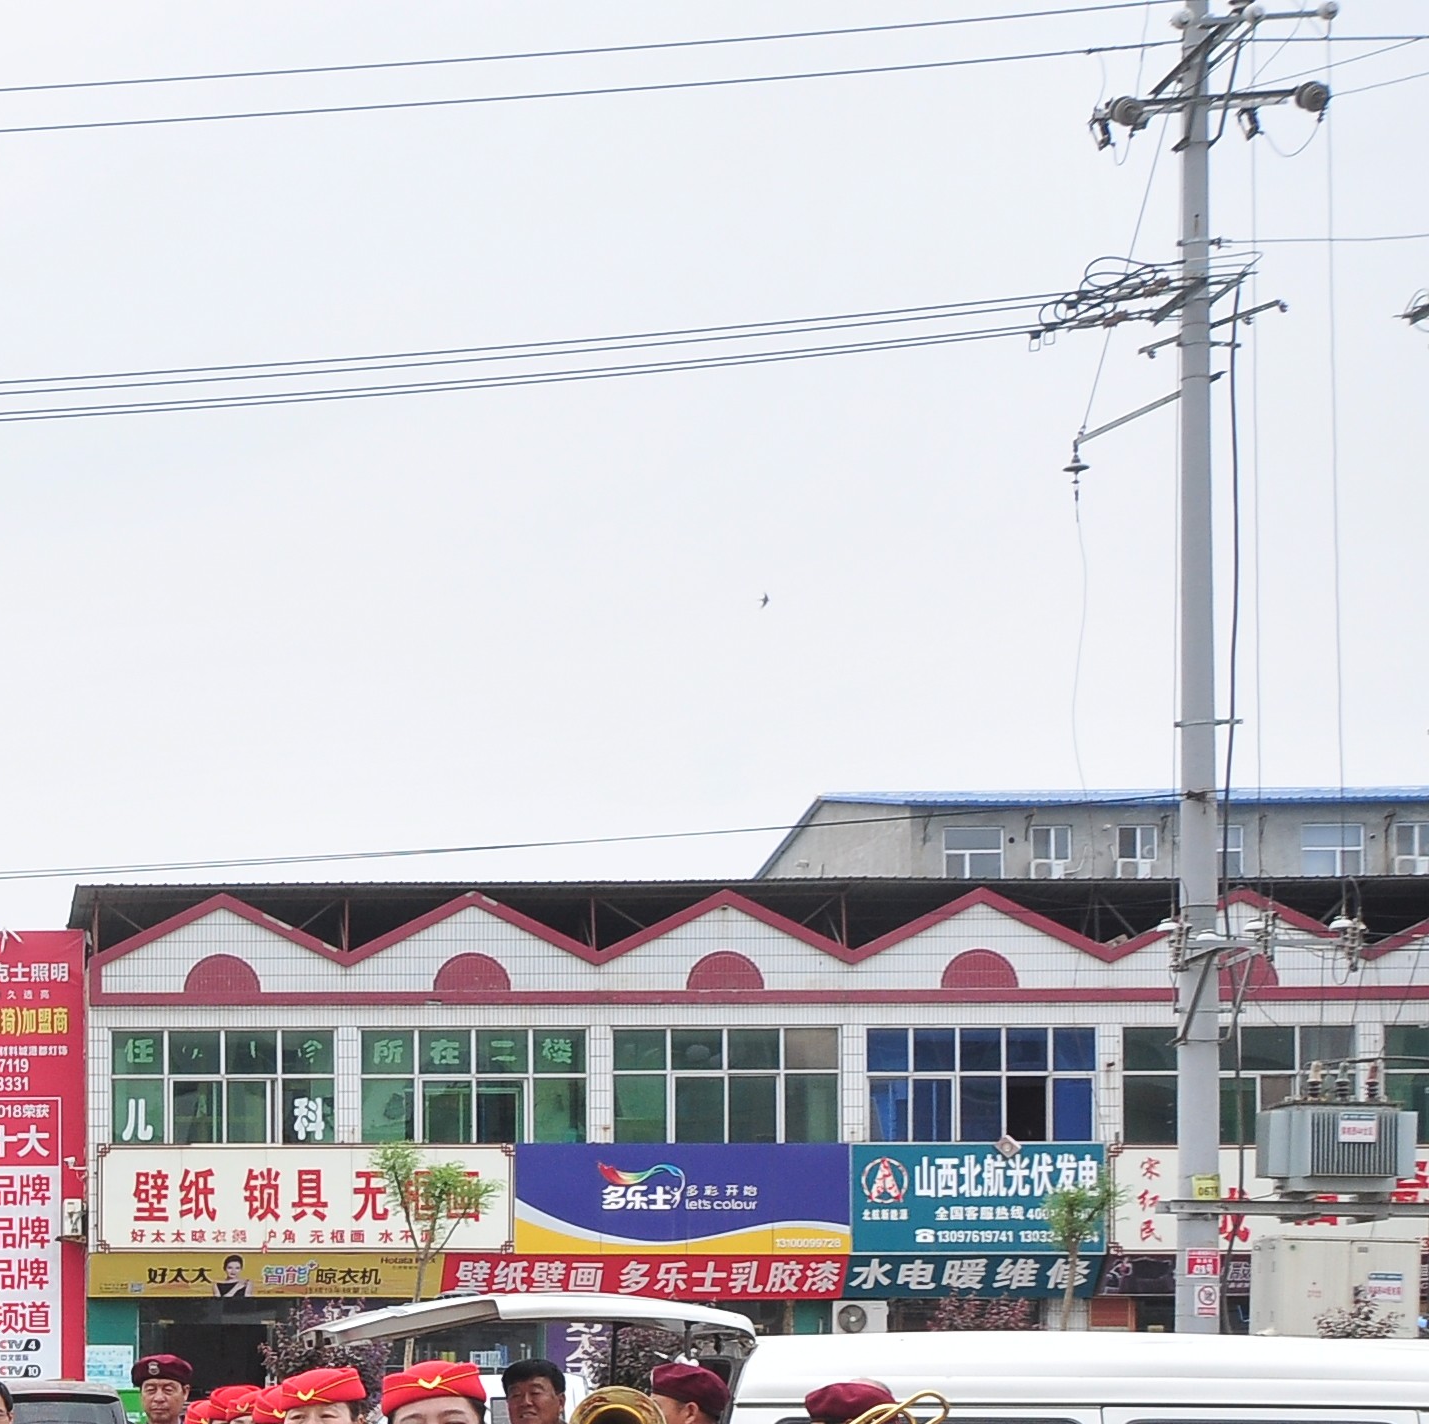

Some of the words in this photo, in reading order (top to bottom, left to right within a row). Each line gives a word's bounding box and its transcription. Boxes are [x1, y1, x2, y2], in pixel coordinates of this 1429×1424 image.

[914, 1153, 1099, 1198] 山西北航光伏发电
[133, 1169, 217, 1223] 壁纸
[243, 1168, 328, 1222] 锁具
[601, 1185, 672, 1211] 多乐士
[686, 1185, 758, 1197] 多彩开始
[713, 1199, 758, 1210] colour
[934, 1205, 1025, 1221] 全国客服热线
[147, 1267, 212, 1285] 好太太
[262, 1264, 311, 1286] 智能
[315, 1267, 382, 1286] 晾衣机
[455, 1260, 604, 1294] 壁纸壁画
[617, 1260, 841, 1293] 多乐士乳胶漆
[849, 1258, 1092, 1290] 水电暖维修
